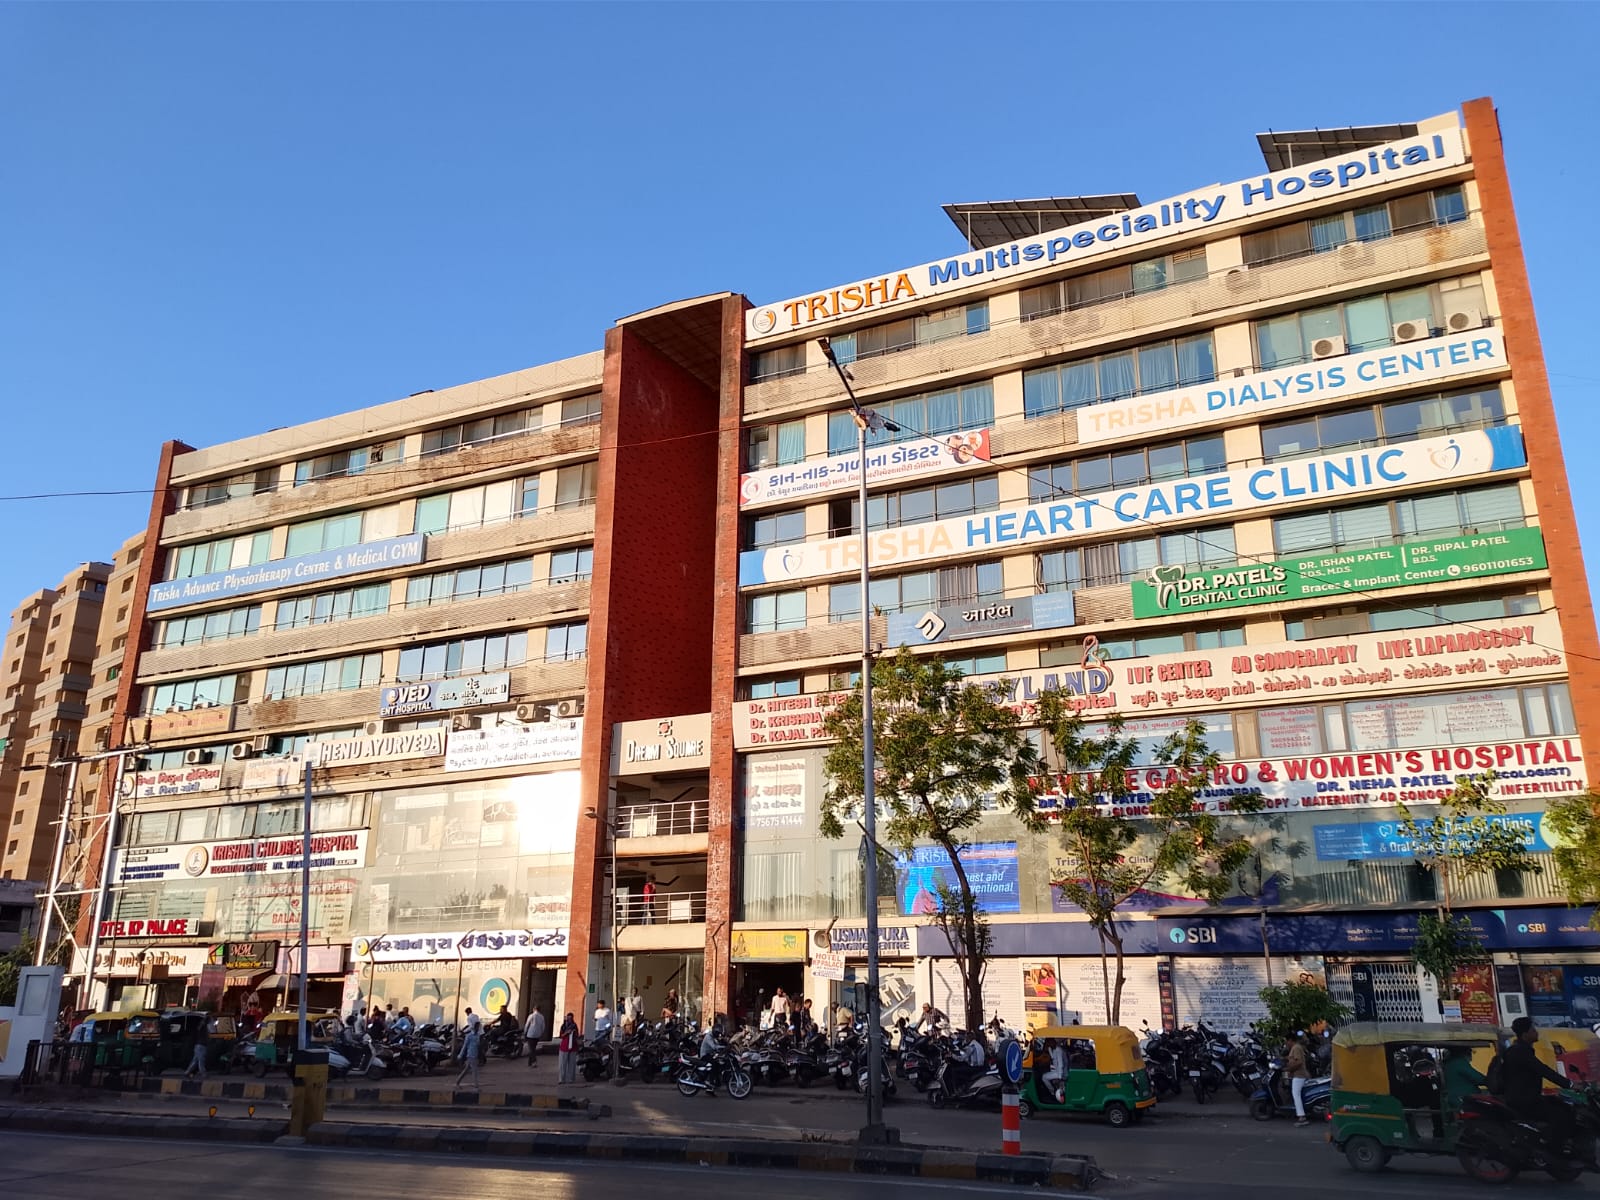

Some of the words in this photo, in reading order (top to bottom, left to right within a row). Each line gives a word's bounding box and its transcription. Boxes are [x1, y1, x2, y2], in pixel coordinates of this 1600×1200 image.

[784, 273, 916, 325] TRISHA
[929, 195, 1225, 287] Multispeciality
[1242, 134, 1445, 206] Hospital
[1089, 397, 1196, 432] TRISHA
[1206, 366, 1346, 411] DIALYSIS
[1357, 338, 1495, 382] CENTER
[966, 498, 1100, 547] HEART
[1113, 476, 1233, 523] CARE
[1248, 448, 1407, 500] CLINIC
[1411, 545, 1431, 556] DR.
[1434, 541, 1469, 553] RIPAL
[1471, 535, 1509, 548] PATEL
[335, 555, 343, 568] &
[1299, 560, 1317, 571] DR.
[1320, 556, 1355, 567] ISHAN
[1357, 551, 1394, 563] PATEL
[1179, 577, 1212, 594] DR.
[1213, 565, 1287, 588] PATEL'S
[1301, 582, 1340, 595] Braces
[1342, 579, 1352, 589] &
[1354, 574, 1400, 588] Implant
[1404, 568, 1446, 580] Center
[1462, 556, 1534, 573] 9601101653
[1179, 590, 1236, 607] DENTAL
[1237, 583, 1288, 600] CLINIC
[962, 602, 1014, 623] આરંભ
[1127, 666, 1153, 684] IVF
[1157, 659, 1212, 682] CENTER
[1232, 655, 1252, 674] 4D
[1254, 643, 1358, 672] SONOGRAPHY
[1376, 638, 1412, 660] LIVE
[1415, 625, 1534, 656] LAPAROSCOPY
[397, 684, 431, 702] VED
[381, 706, 395, 716] ENT
[395, 701, 433, 715] HOSPITAL
[749, 703, 766, 714] Dr.
[767, 698, 812, 713] HITESH
[750, 718, 766, 729] Dr.
[768, 712, 823, 728] KRISHNA
[365, 732, 444, 757] AYURVEDA
[750, 732, 767, 743] Dr.
[769, 728, 809, 742] KAJAL
[1257, 760, 1278, 783] &
[1284, 749, 1424, 781] WOMEN'S
[1433, 738, 1582, 772] HOSPITAL
[1316, 780, 1344, 793] DR.
[1349, 776, 1397, 791] NEHA
[1400, 773, 1450, 788] PATEL
[1302, 794, 1369, 807] MATERNITY
[1378, 791, 1397, 803] 4D
[1500, 780, 1584, 796] INFERTILITY
[212, 843, 253, 861] KRISHNA
[309, 834, 359, 853] HOSPITAL
[1389, 841, 1410, 853] Oral
[984, 871, 1003, 883] and
[100, 920, 126, 937] OTEL
[128, 920, 144, 936] KP
[147, 919, 188, 935] PALACE
[1188, 927, 1217, 944] SBI
[1528, 922, 1547, 934] SBI
[879, 941, 910, 950] ENTRE
[376, 962, 430, 973] USMANPURA
[431, 961, 473, 972] IMAGING
[477, 960, 518, 971] CENTRE
[815, 953, 841, 962] HOTEL
